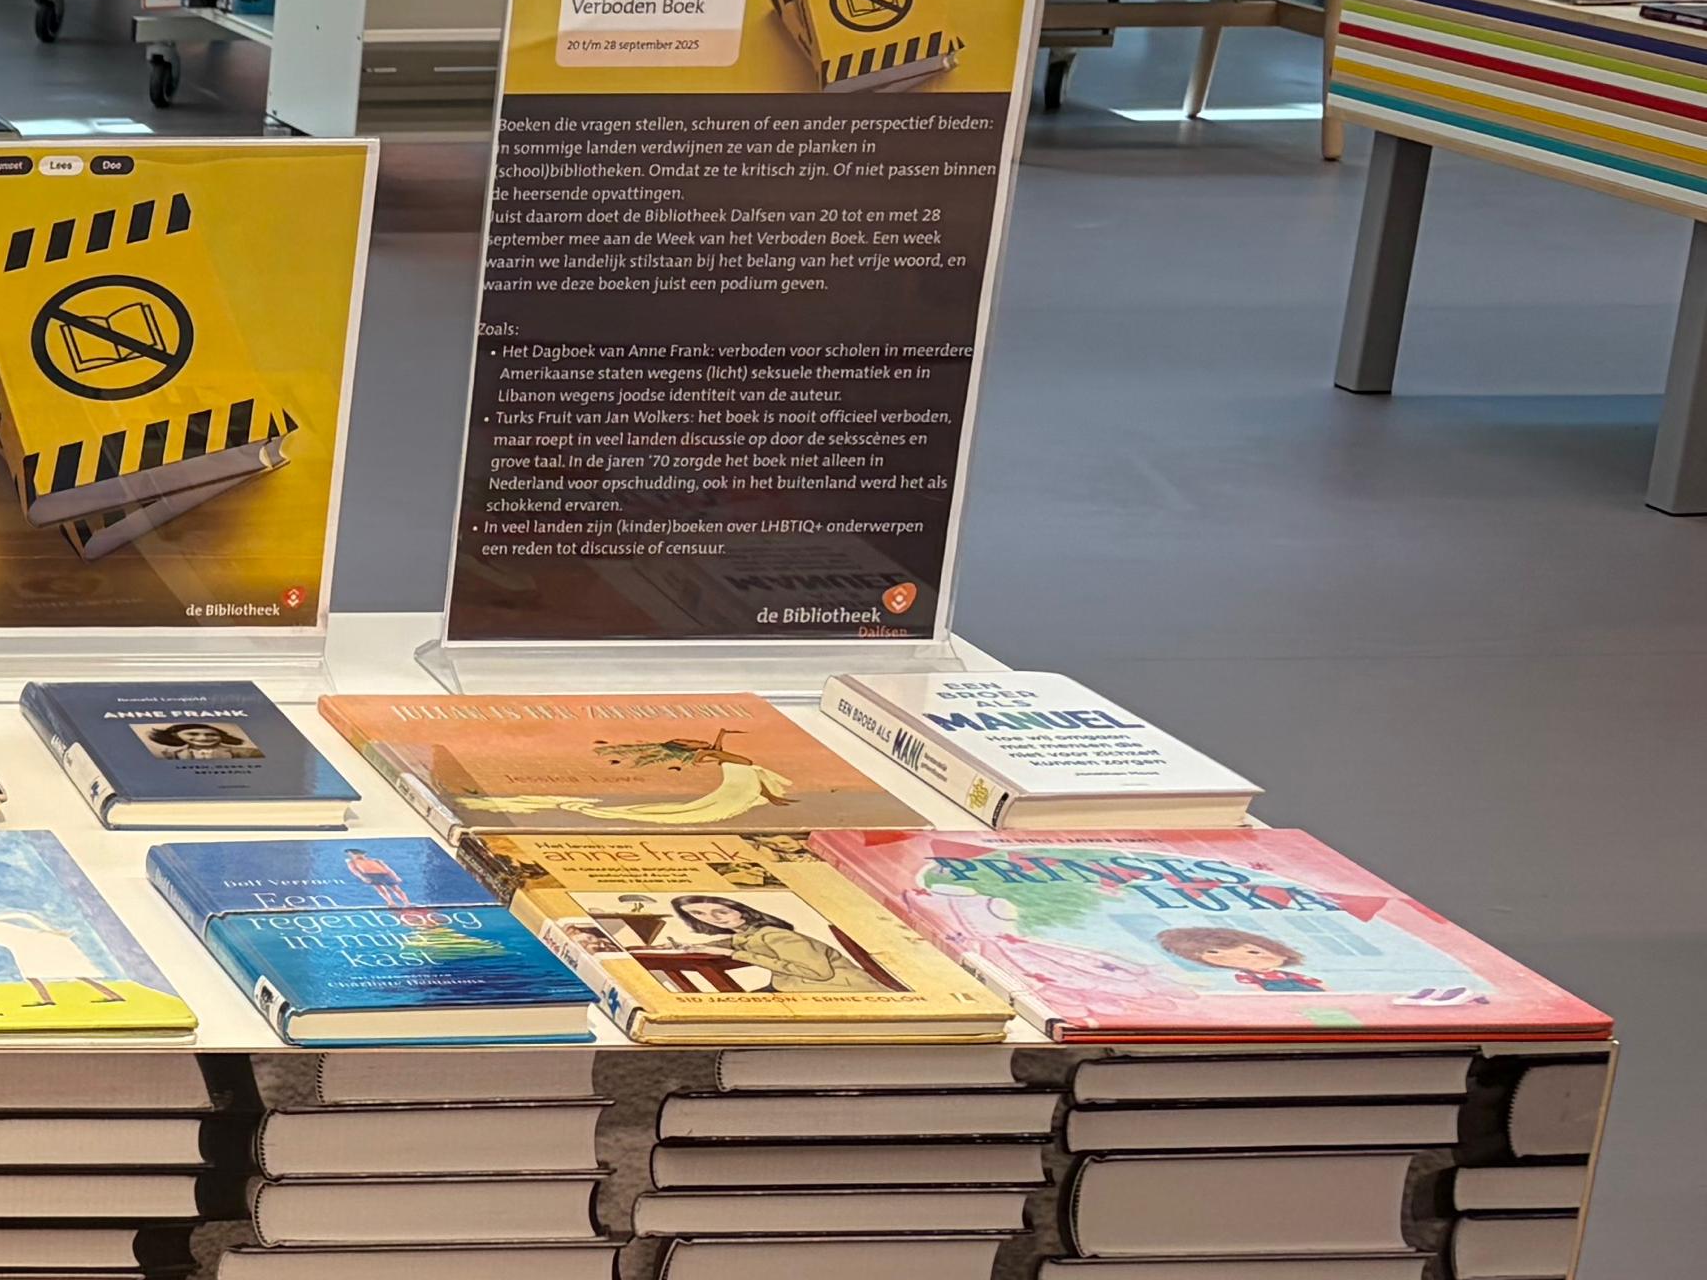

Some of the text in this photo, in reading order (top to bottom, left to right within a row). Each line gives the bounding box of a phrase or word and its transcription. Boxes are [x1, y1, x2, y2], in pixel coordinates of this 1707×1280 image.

[496, 408, 952, 425] Turks Fruit van Jan Wolkers: het boek is nooit officieel verboden,
[484, 519, 924, 537] In veel landen zijn (kinder)boeken over LHBTIQ+ onderwerpen
[185, 603, 280, 617] de Bibliotheek
[756, 606, 881, 624] de Bibliotheek
[936, 690, 1040, 699] BROER
[943, 682, 1001, 690] EEN
[976, 699, 1032, 707] ALS
[103, 709, 249, 718] ANNE FRANK
[923, 710, 1145, 732] MANUEL
[543, 841, 750, 862] anne frank
[924, 855, 1252, 885] PRINSES
[252, 892, 339, 908] Een
[1128, 883, 1352, 913] LUKA
[248, 909, 483, 934] regenboog
[280, 932, 327, 950] in
[341, 949, 442, 968] kast
